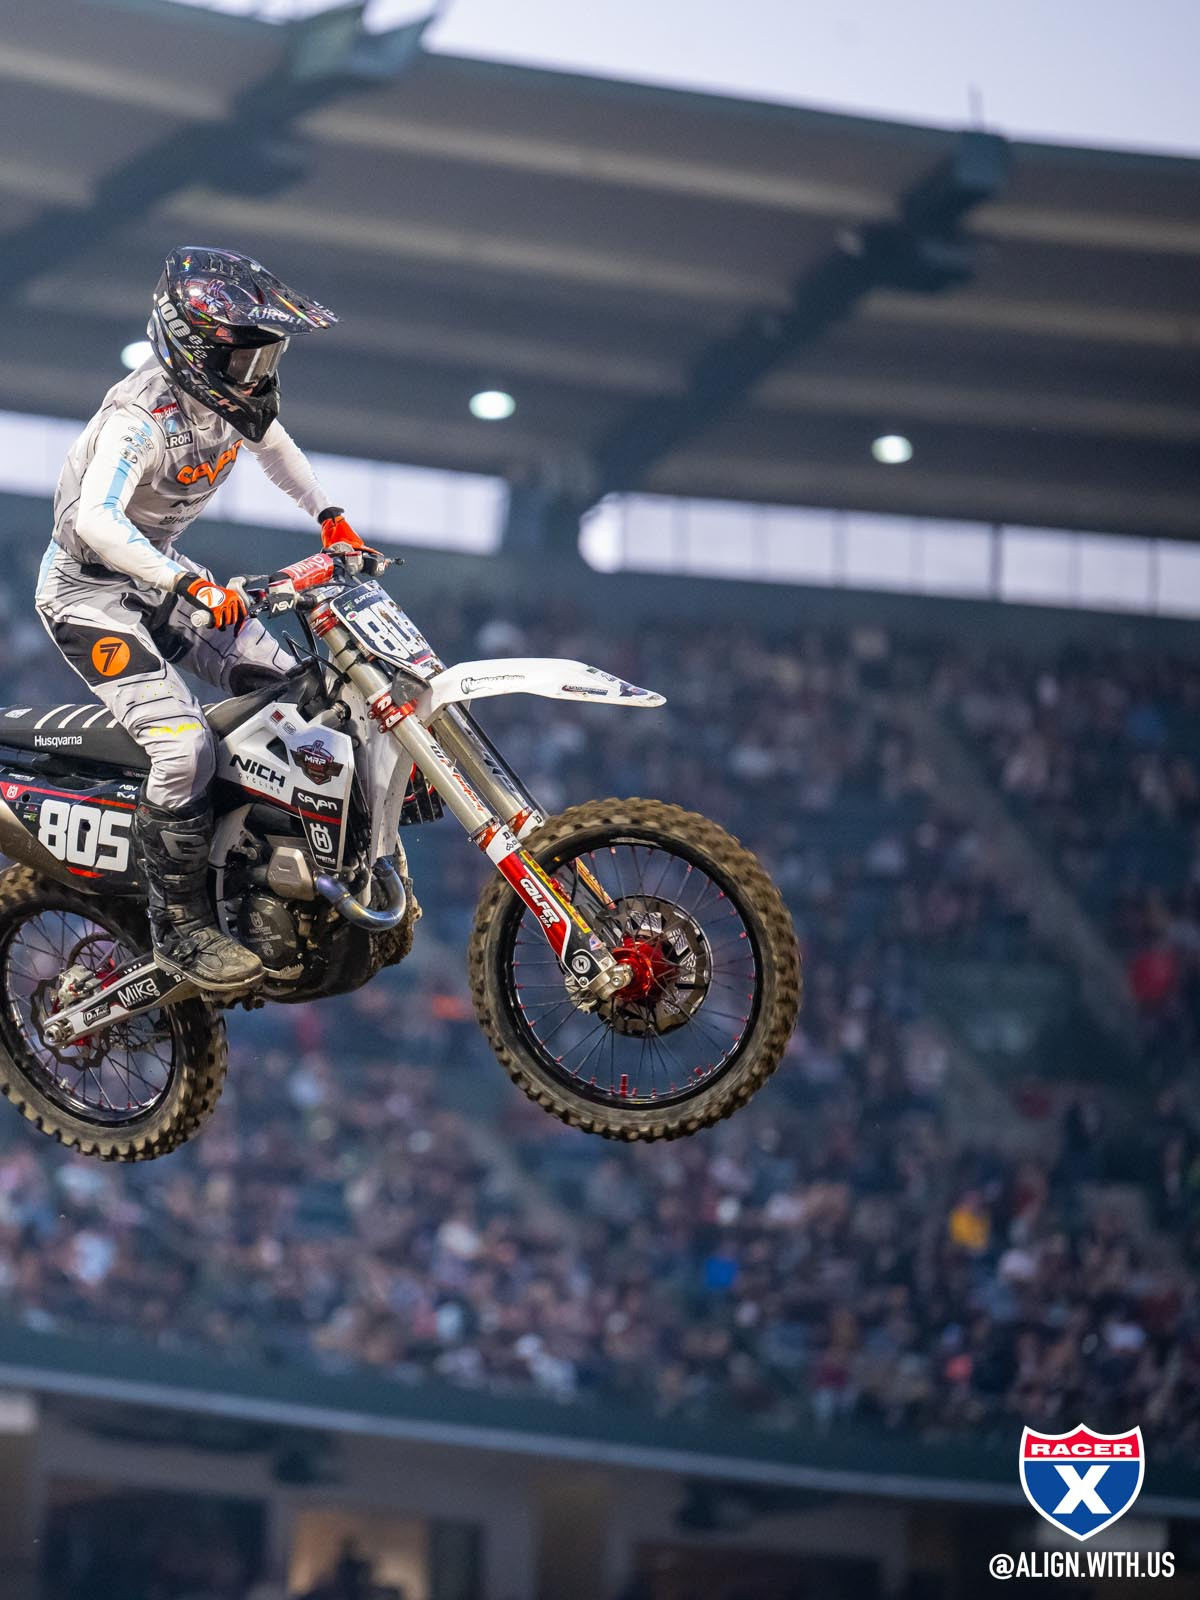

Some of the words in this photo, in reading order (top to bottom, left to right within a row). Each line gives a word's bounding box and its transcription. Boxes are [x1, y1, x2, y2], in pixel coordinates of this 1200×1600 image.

[271, 600, 295, 613] ASV
[99, 642, 123, 673] 7
[34, 735, 82, 748] Husqvarna
[304, 754, 326, 765] MRP
[229, 754, 286, 788] NICH
[118, 784, 138, 792] ASV
[38, 799, 132, 872] 805
[117, 977, 157, 1008] Mika
